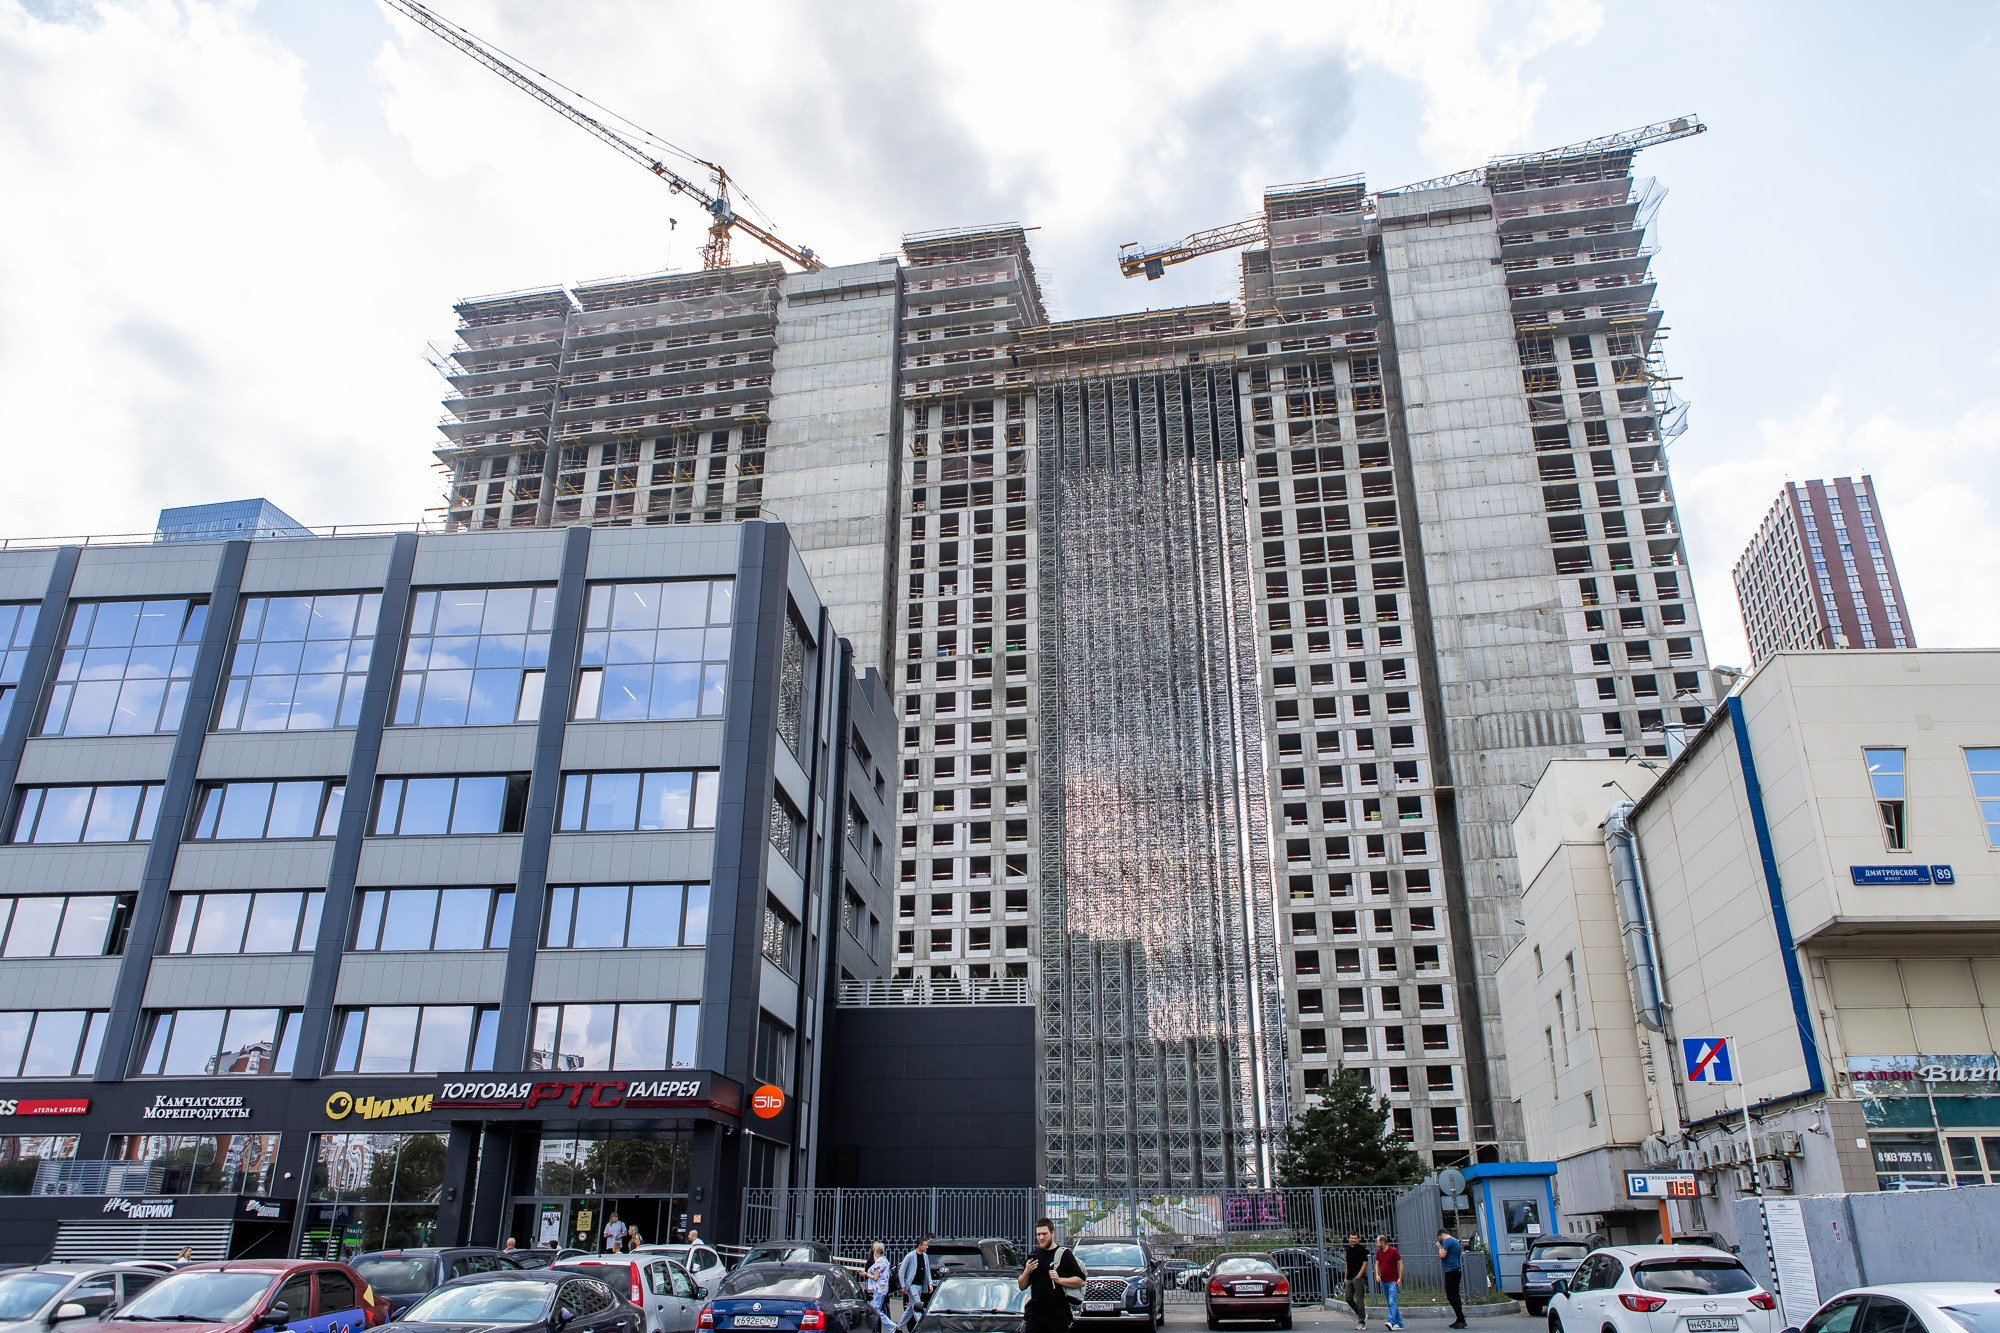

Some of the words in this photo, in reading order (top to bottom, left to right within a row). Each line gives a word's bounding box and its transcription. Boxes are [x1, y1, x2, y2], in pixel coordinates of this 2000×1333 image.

[1865, 869, 1919, 877] ДМИТРОВСКОЕ
[1936, 868, 1951, 879] 89
[1855, 1071, 1913, 1080] САЛОН
[440, 1082, 532, 1099] ТОРГОВАЯ
[526, 1081, 627, 1109] РТС
[626, 1081, 702, 1098] ГАЛЕРЕЯ
[1878, 1151, 1884, 1162] 8
[1884, 1151, 1898, 1162] 903
[1911, 1151, 1922, 1162] 75
[1922, 1151, 1933, 1162] 16
[1673, 1181, 1696, 1196] 163
[127, 1204, 174, 1218] ПАТРИКИ
